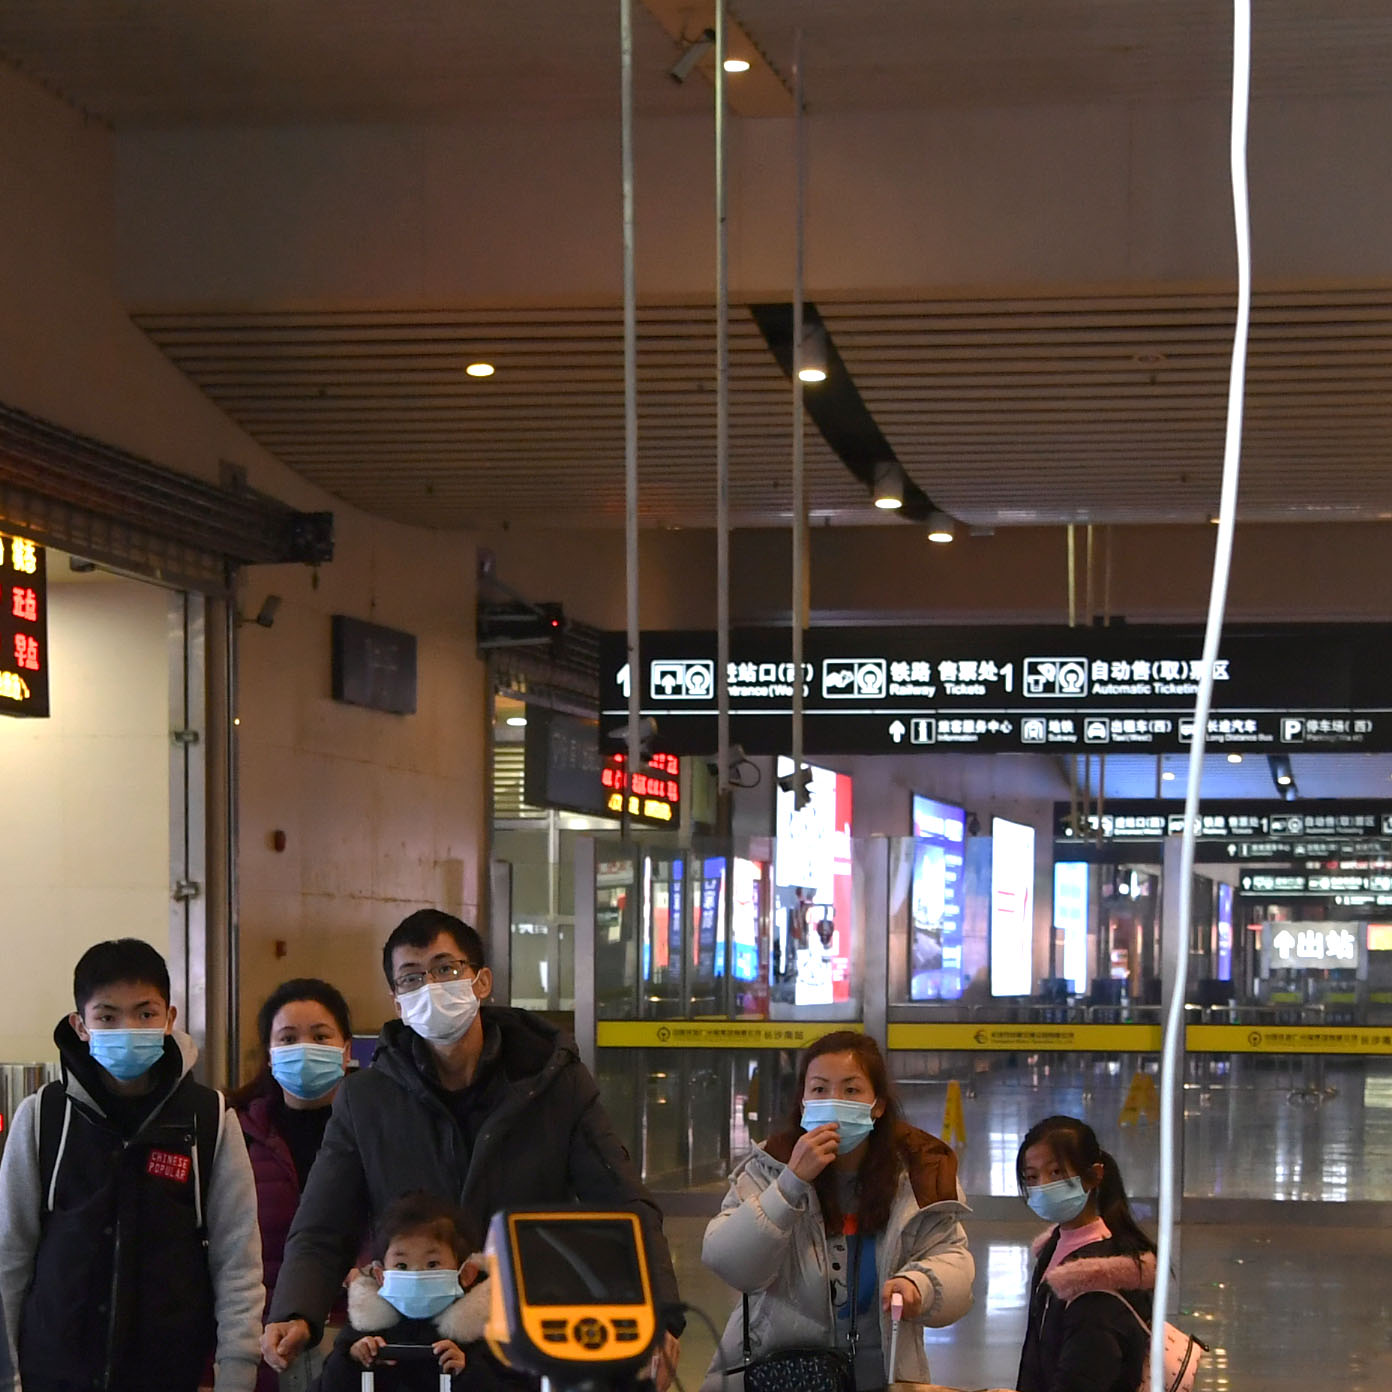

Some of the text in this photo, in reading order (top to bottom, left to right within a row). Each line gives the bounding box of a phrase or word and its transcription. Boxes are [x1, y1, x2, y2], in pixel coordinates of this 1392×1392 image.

[12, 586, 37, 622] 正点
[14, 632, 39, 670] 早点
[890, 661, 931, 682] 铁路
[889, 683, 936, 698] Railway
[944, 683, 986, 695] Tickets
[1091, 683, 1152, 694] Automatic
[1153, 683, 1200, 694] Ticketin
[1297, 930, 1355, 959] 出站
[148, 1161, 186, 1180] POPULAR
[151, 1151, 189, 1170] CHINESE
